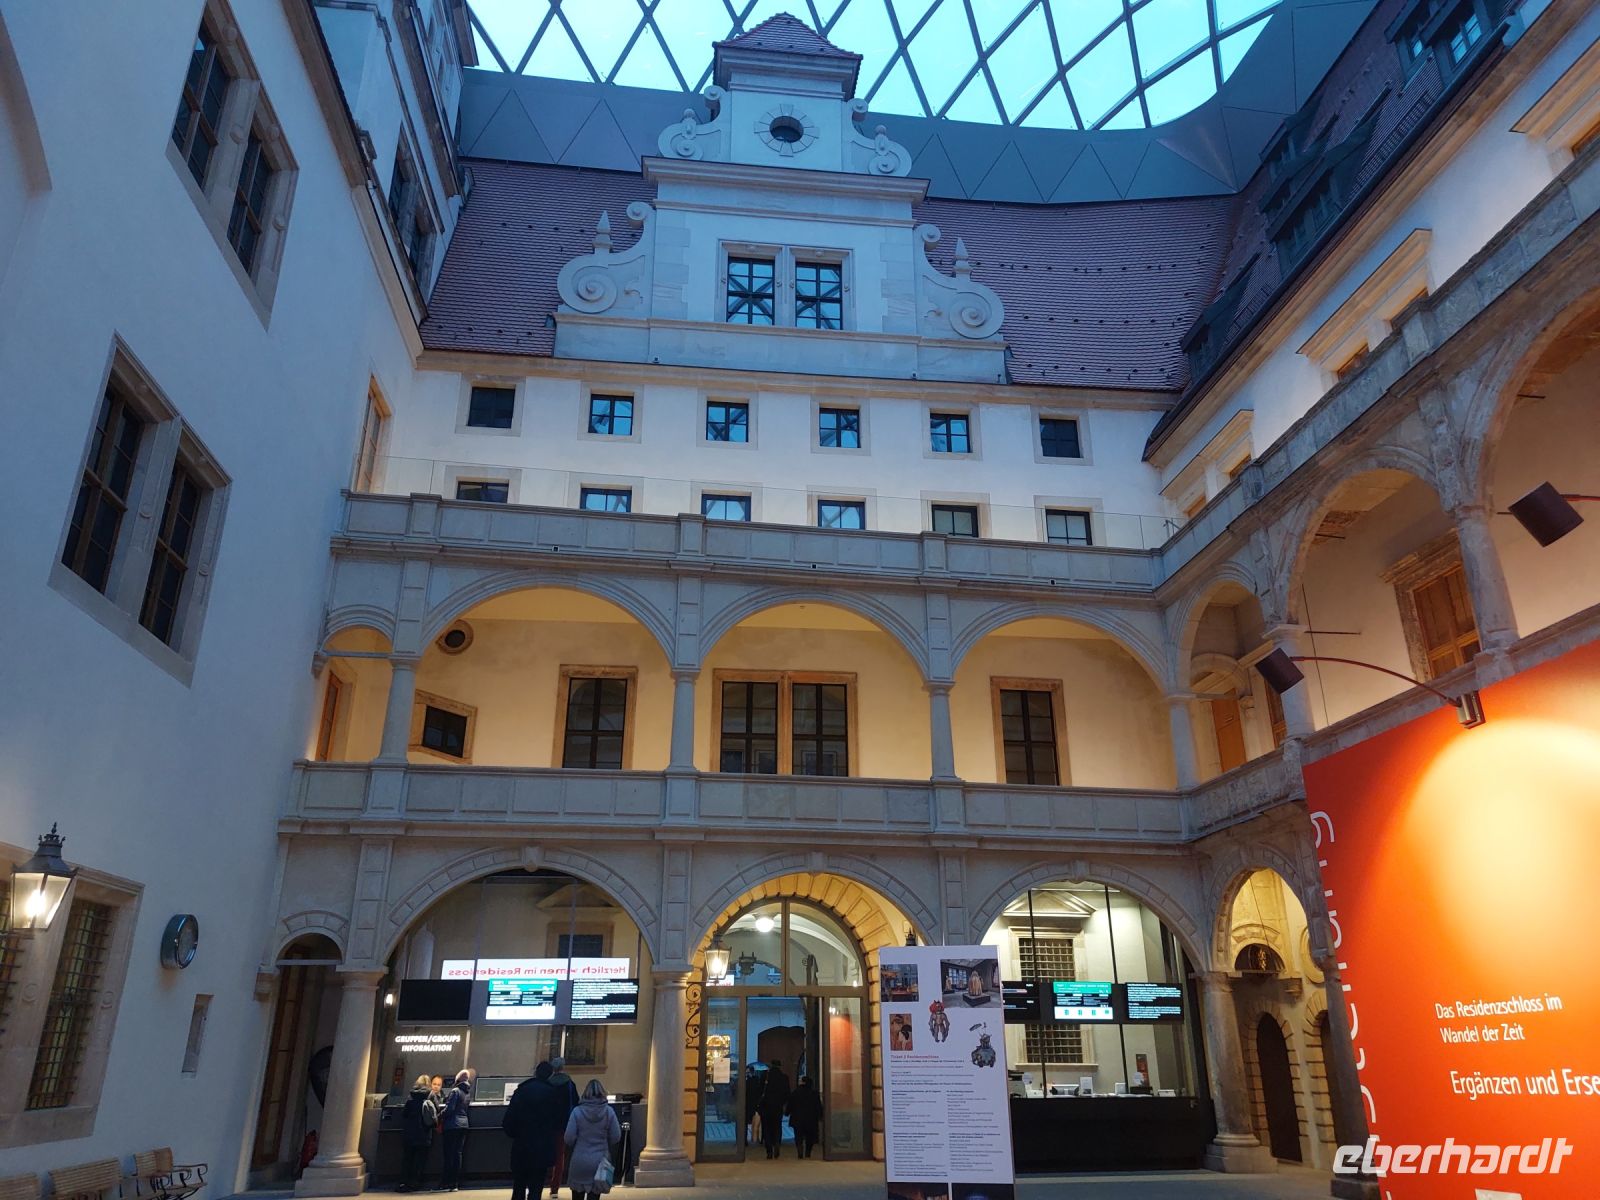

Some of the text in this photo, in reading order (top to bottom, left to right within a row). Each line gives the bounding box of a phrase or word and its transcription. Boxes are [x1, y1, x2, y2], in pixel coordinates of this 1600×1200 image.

[1435, 992, 1563, 1019] Das Residenzschloss im
[394, 1034, 461, 1044] GRUPPEN/GROUPS
[1440, 1022, 1525, 1044] Wandel der Zeit
[401, 1044, 453, 1052] INFORMATION
[1450, 1070, 1522, 1101] Ergänzen
[1525, 1069, 1560, 1095] und
